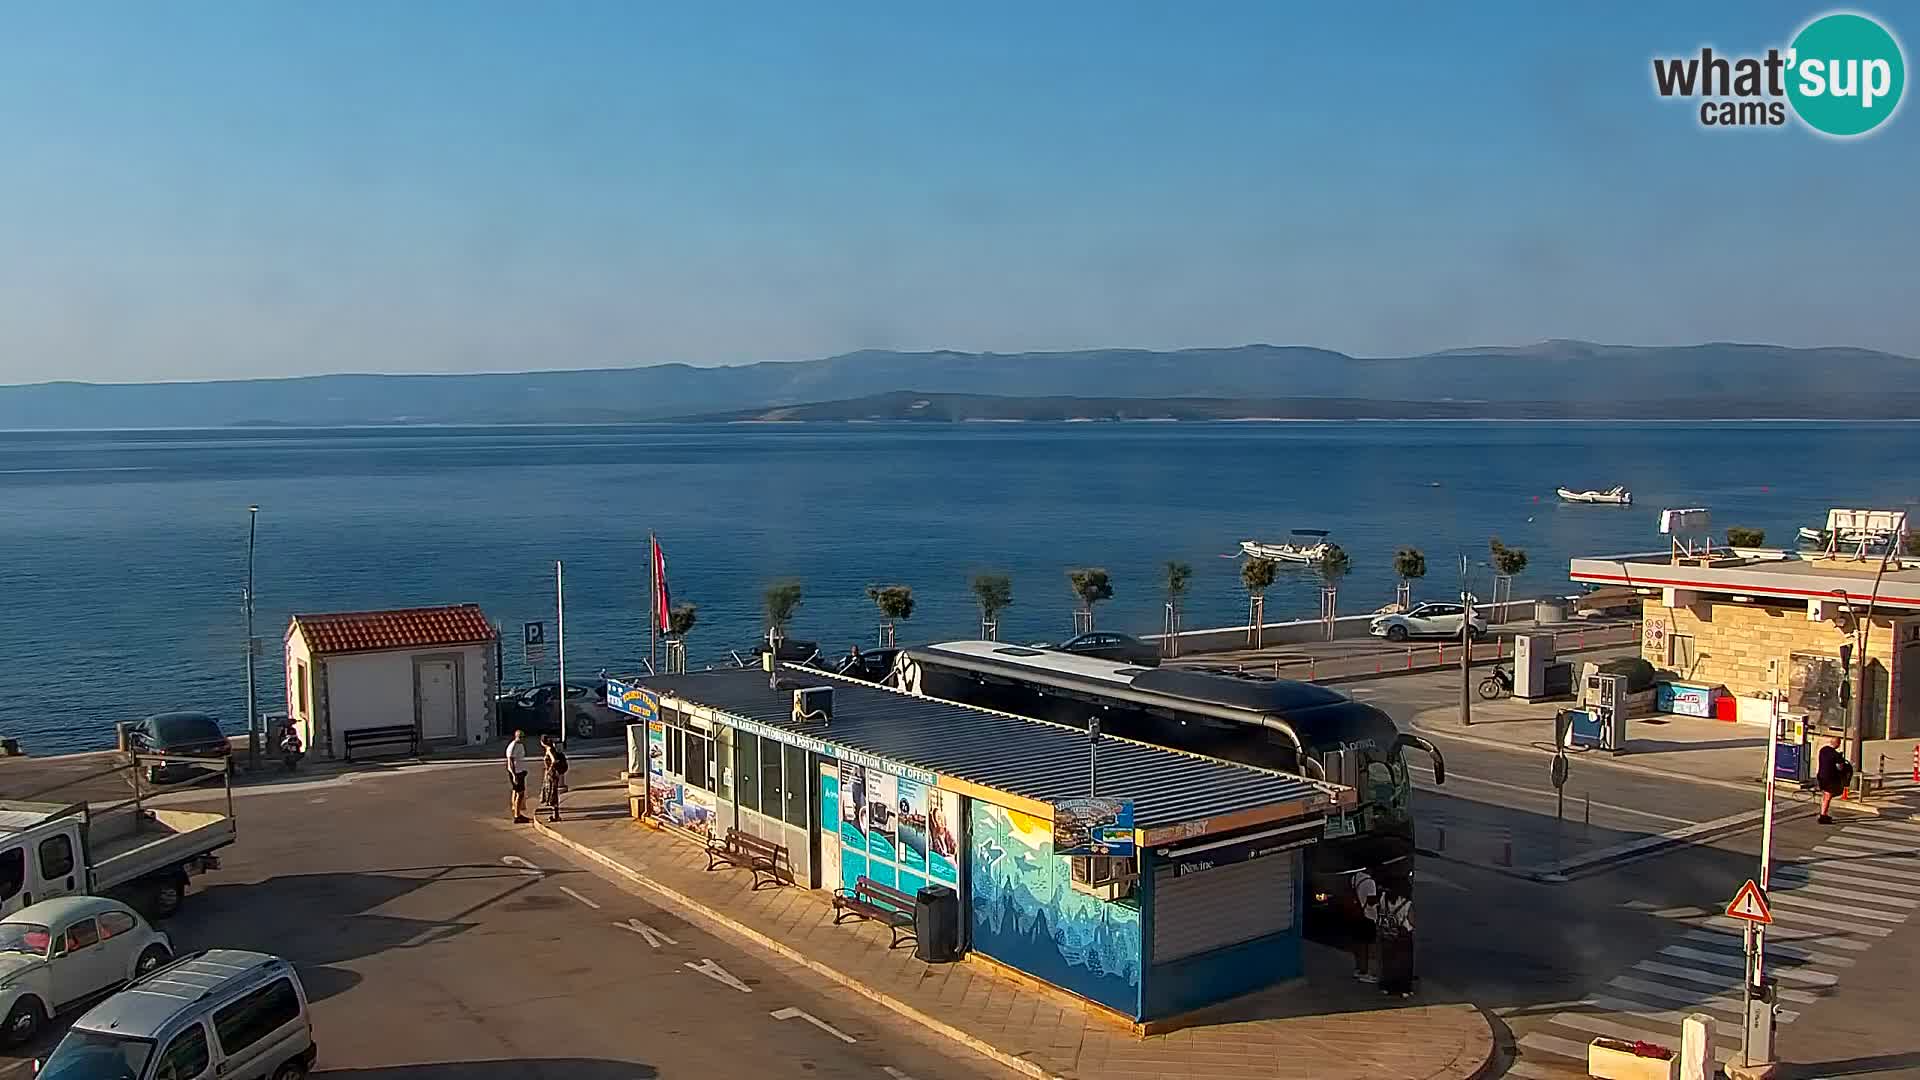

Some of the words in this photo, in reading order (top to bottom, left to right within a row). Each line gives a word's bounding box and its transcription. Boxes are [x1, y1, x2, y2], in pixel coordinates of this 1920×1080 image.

[529, 625, 540, 642] P
[834, 748, 849, 761] BUS
[849, 752, 880, 770] STATION
[882, 761, 907, 777] TICKET
[907, 767, 934, 784] OFFICE
